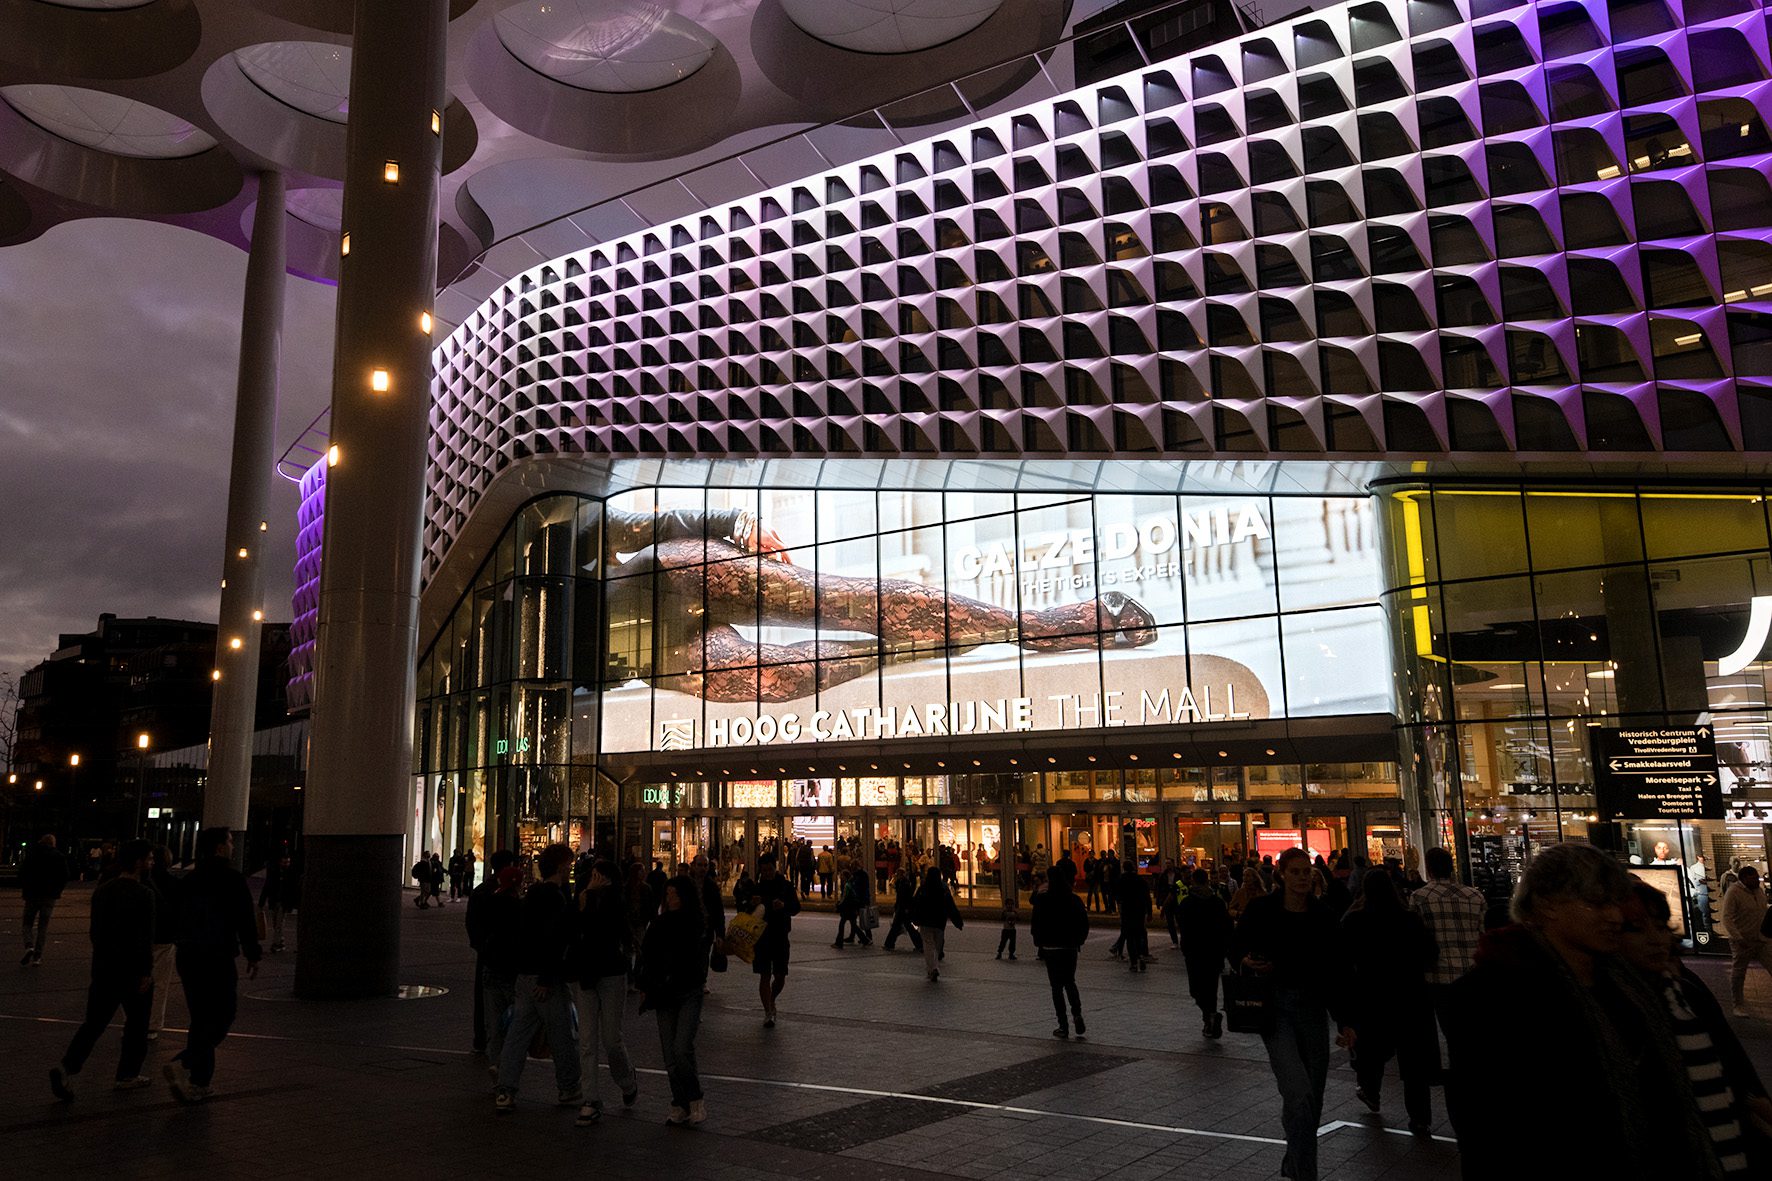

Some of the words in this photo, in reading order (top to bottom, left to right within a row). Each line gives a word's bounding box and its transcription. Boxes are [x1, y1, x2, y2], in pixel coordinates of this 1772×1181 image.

[953, 503, 1270, 580] CALZEDONIA
[1021, 578, 1051, 595] THE
[709, 714, 802, 746] HOOG
[810, 696, 1033, 743] CATHARIJNE
[1048, 691, 1126, 729] THE
[1140, 684, 1250, 722] MALL
[496, 737, 530, 754] DOLAS
[1628, 737, 1696, 745] Vredenburgplein
[1623, 760, 1691, 768] Smakkelaarsveld
[1646, 776, 1701, 784] Moreelsepark
[643, 788, 681, 804] DOUGLS
